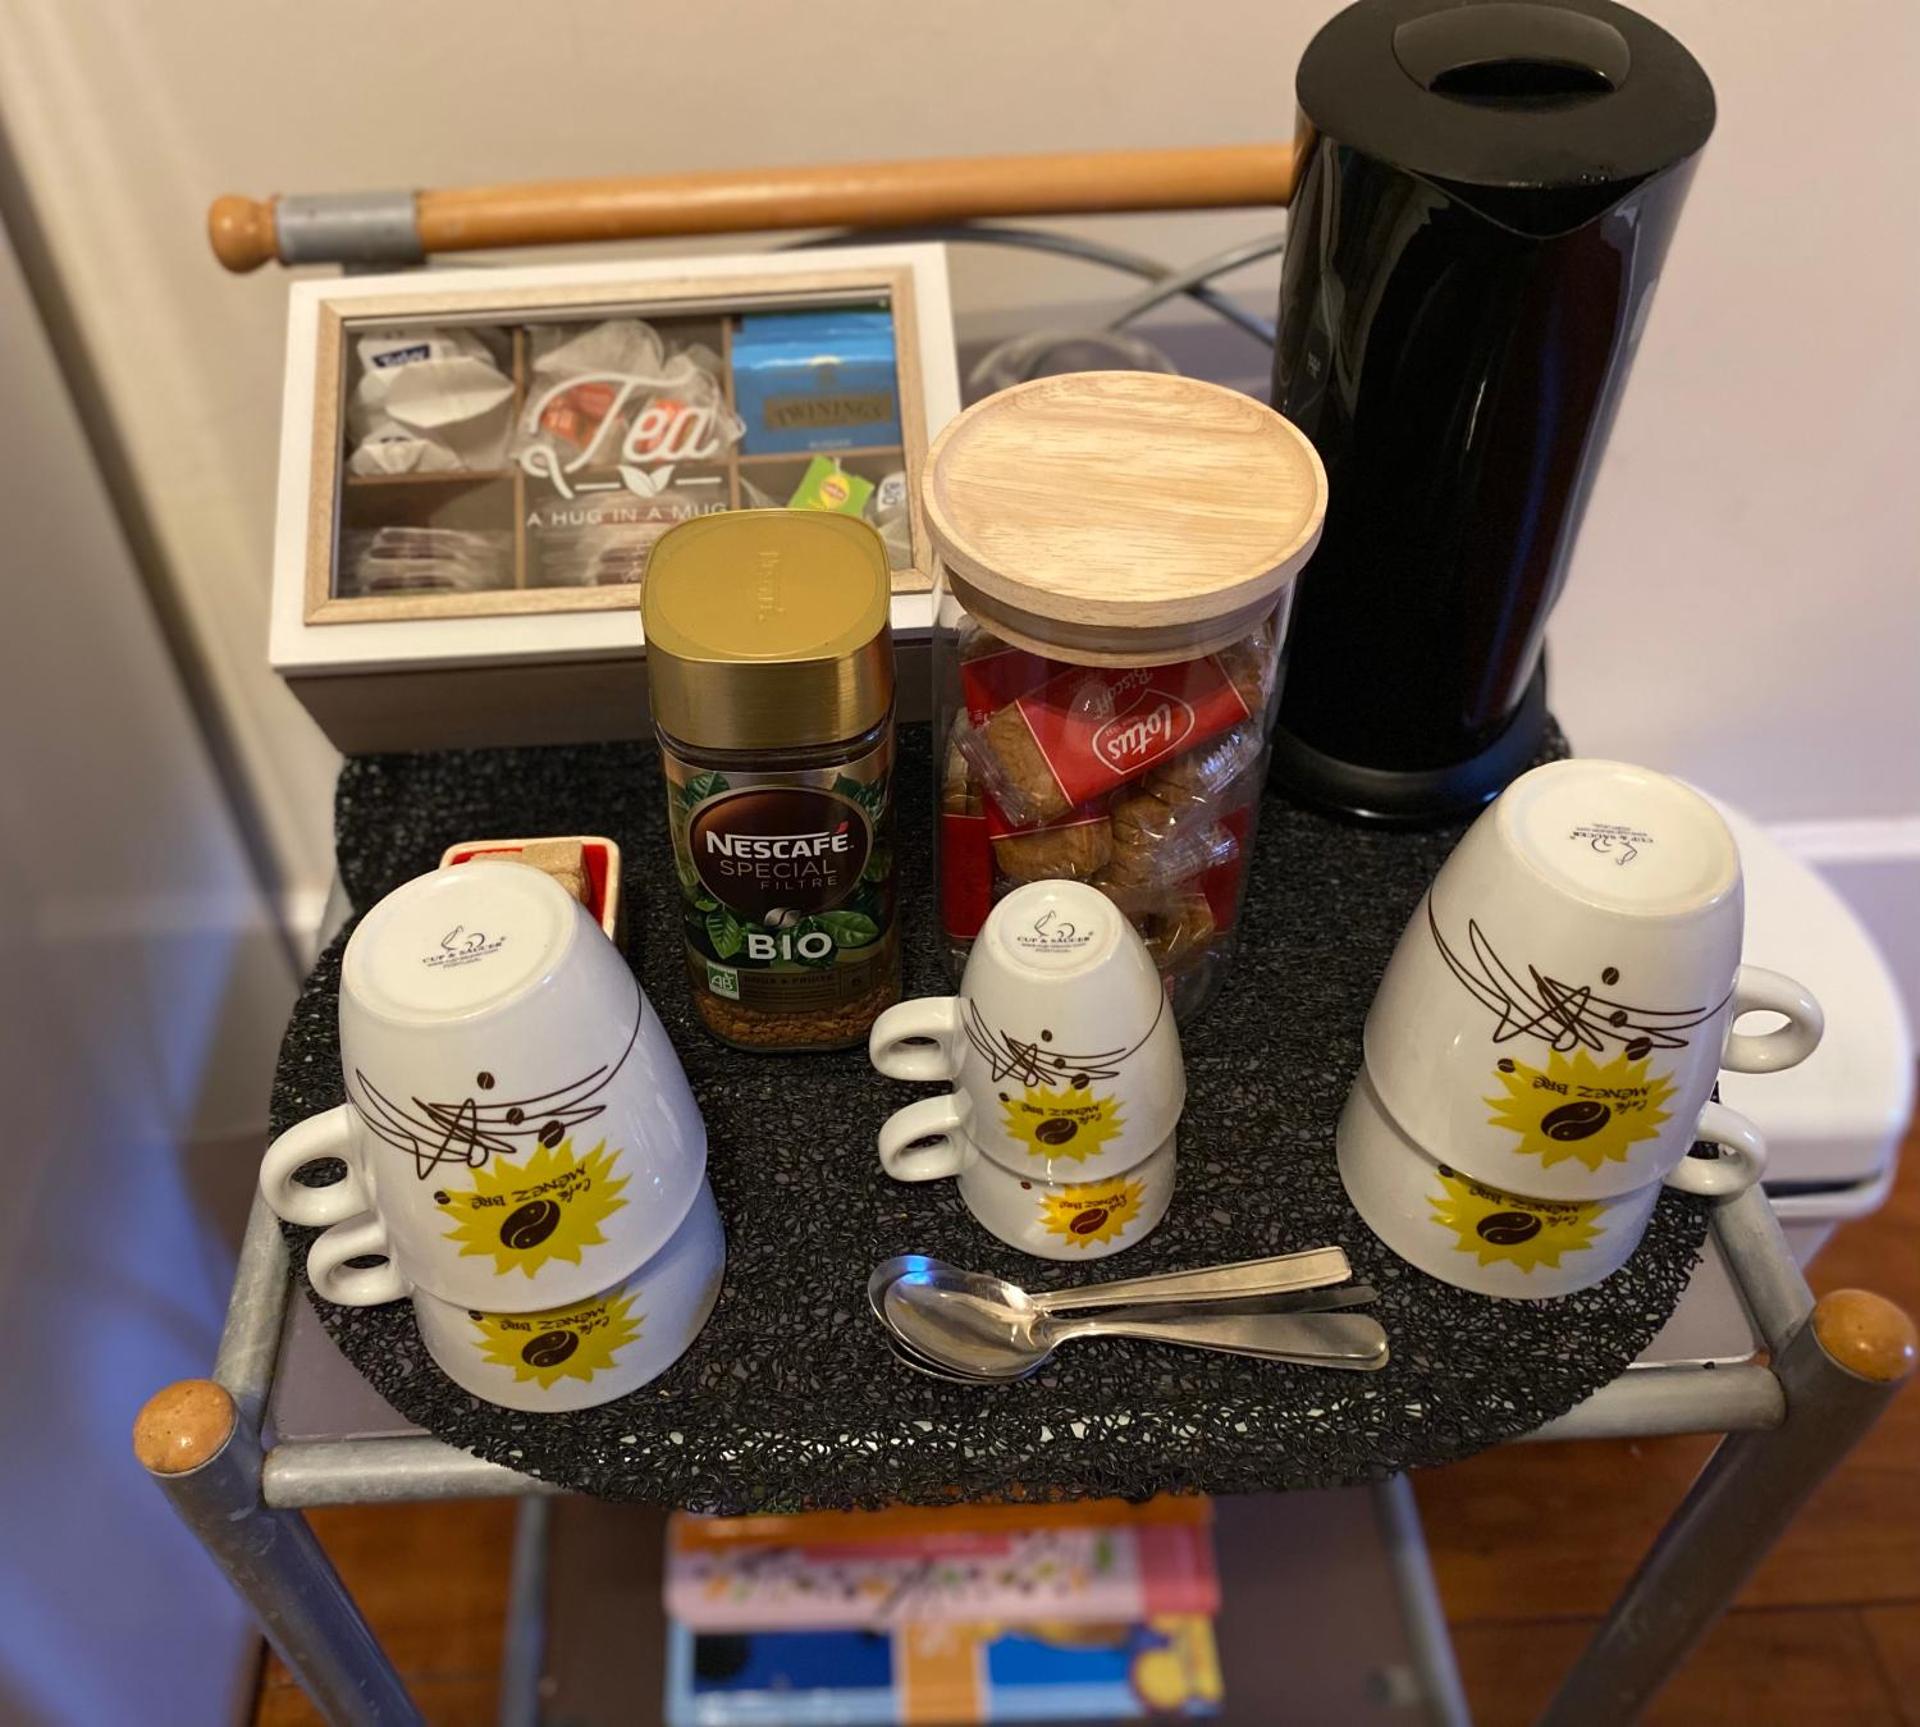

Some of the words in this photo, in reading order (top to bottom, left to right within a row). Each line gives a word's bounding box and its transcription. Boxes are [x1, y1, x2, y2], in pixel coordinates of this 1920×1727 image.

[510, 371, 720, 500] Tea
[526, 511, 543, 527] A
[551, 509, 602, 526] HUG
[613, 507, 637, 523] IN
[645, 506, 664, 520] A
[1107, 702, 1172, 762] Lotus
[719, 859, 837, 879] SPECIAL
[760, 876, 838, 891] FILTRE
[747, 932, 833, 961] BIO
